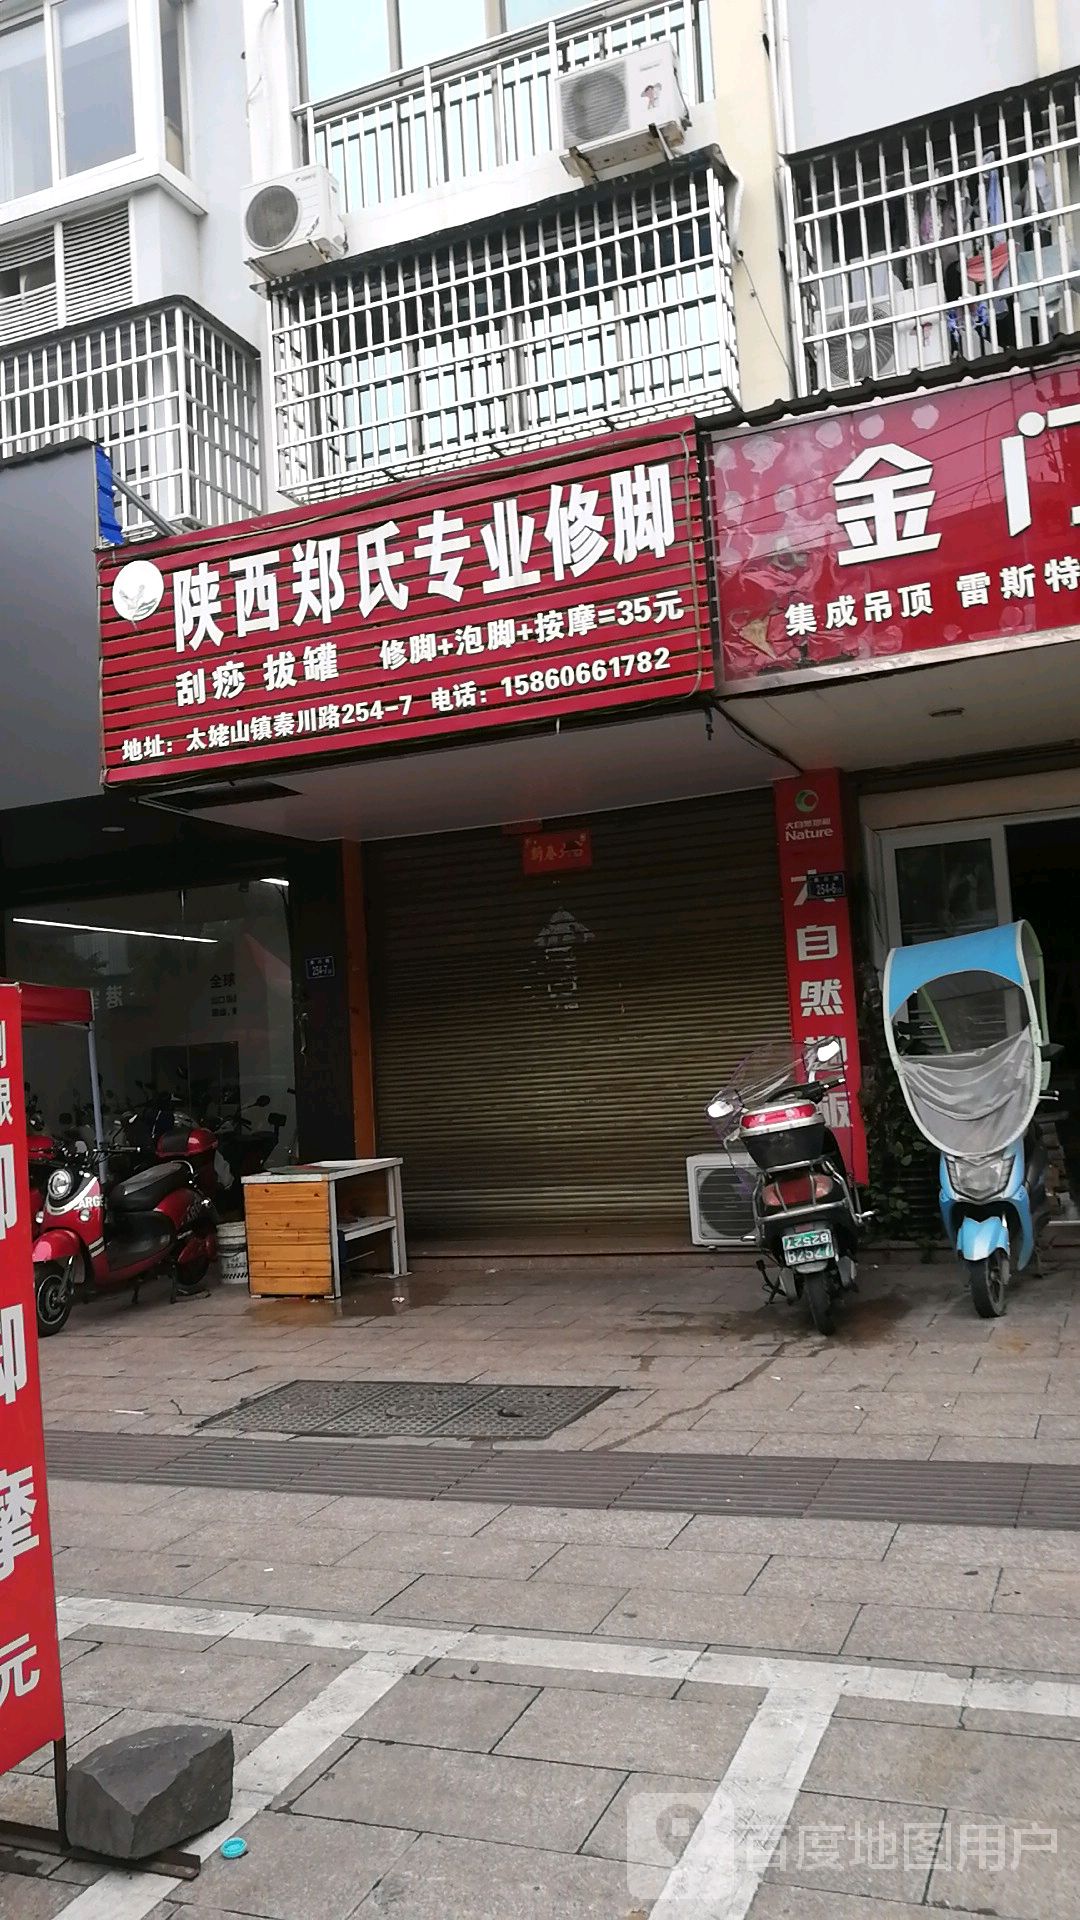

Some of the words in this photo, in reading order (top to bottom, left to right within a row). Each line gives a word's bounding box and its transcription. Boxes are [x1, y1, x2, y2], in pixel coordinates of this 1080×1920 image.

[172, 464, 676, 653] 陕西郑氏专业修脚
[784, 582, 934, 637] 集成吊顶
[956, 555, 1080, 608] 雷斯特
[175, 660, 246, 707] 刮痧
[262, 642, 340, 692] 拔罐
[379, 589, 685, 671] 修脚+泡脚+按摩=35元
[785, 828, 834, 842] Nature
